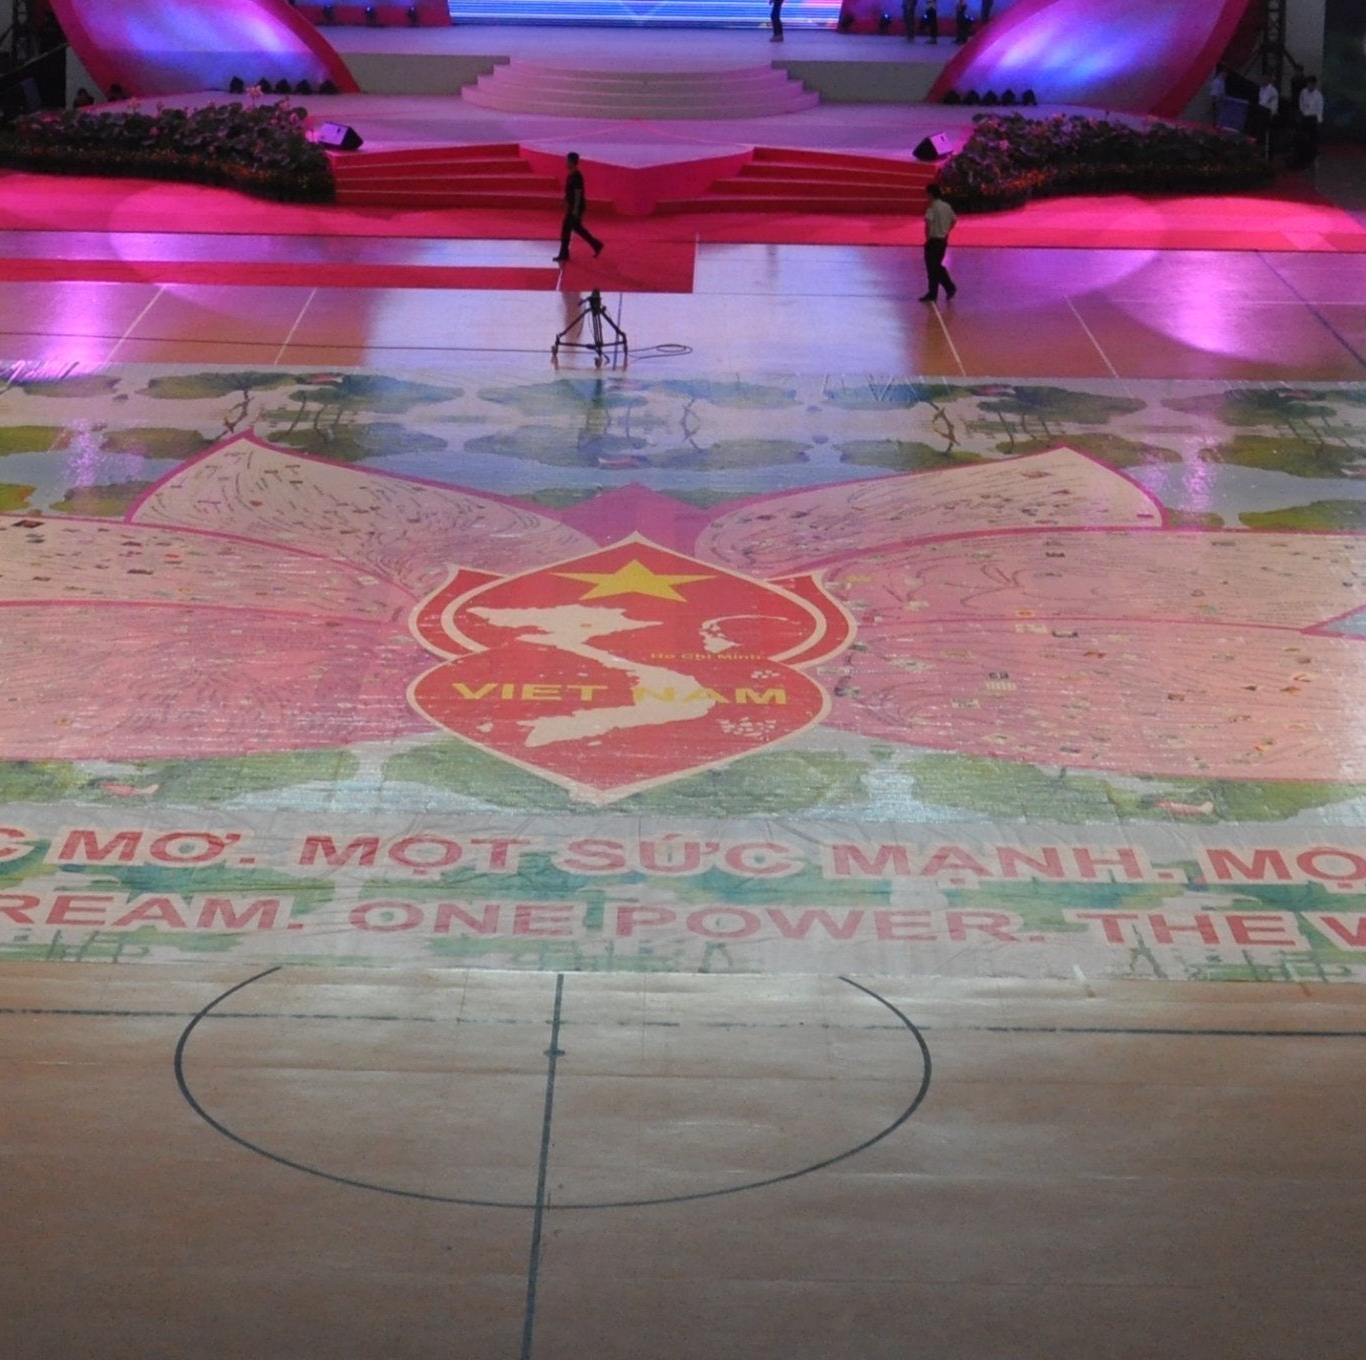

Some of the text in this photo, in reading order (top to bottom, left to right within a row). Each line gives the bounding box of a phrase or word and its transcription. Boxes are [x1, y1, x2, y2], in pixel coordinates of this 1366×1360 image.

[451, 682, 788, 705] VIET NAM
[57, 829, 256, 864] MƠ.
[297, 834, 530, 876] MỘT
[563, 834, 790, 874] SỨC
[832, 844, 1174, 885] MẠNH.
[347, 901, 573, 936] ONE
[615, 905, 1045, 942] POWER.
[1075, 913, 1296, 946] THE
